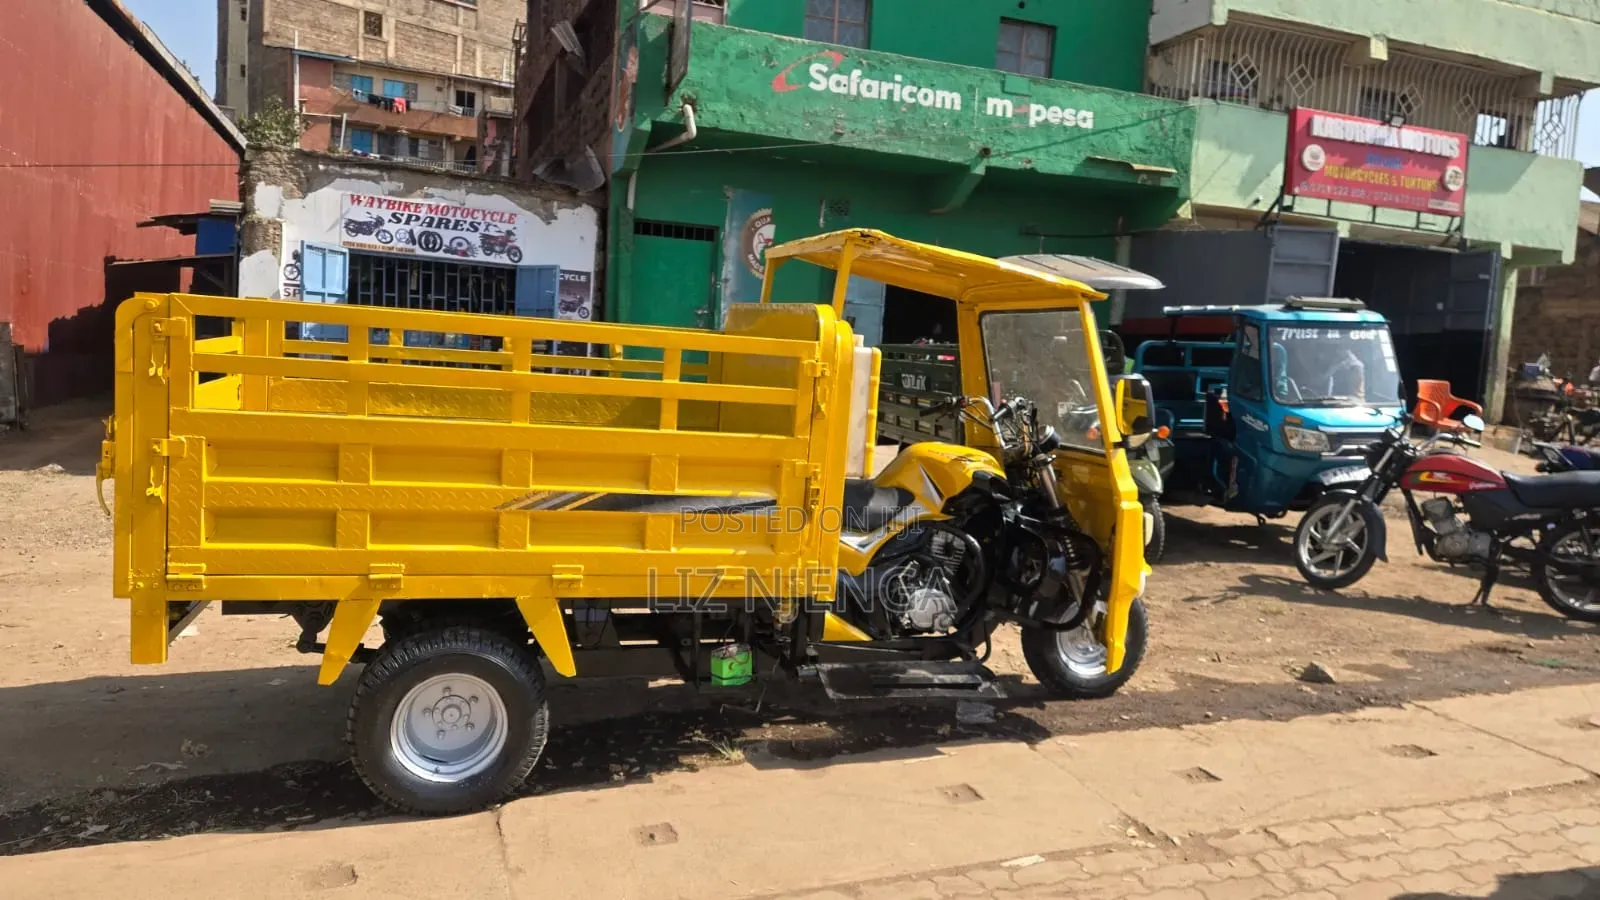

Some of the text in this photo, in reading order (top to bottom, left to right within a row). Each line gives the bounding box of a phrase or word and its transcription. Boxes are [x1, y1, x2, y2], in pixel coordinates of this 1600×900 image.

[808, 62, 962, 111] Safaricom
[1323, 164, 1390, 185] MOTORCYCLES
[349, 194, 518, 225] WAYBIKE MOTOCYCLE
[388, 211, 483, 233] SPARES
